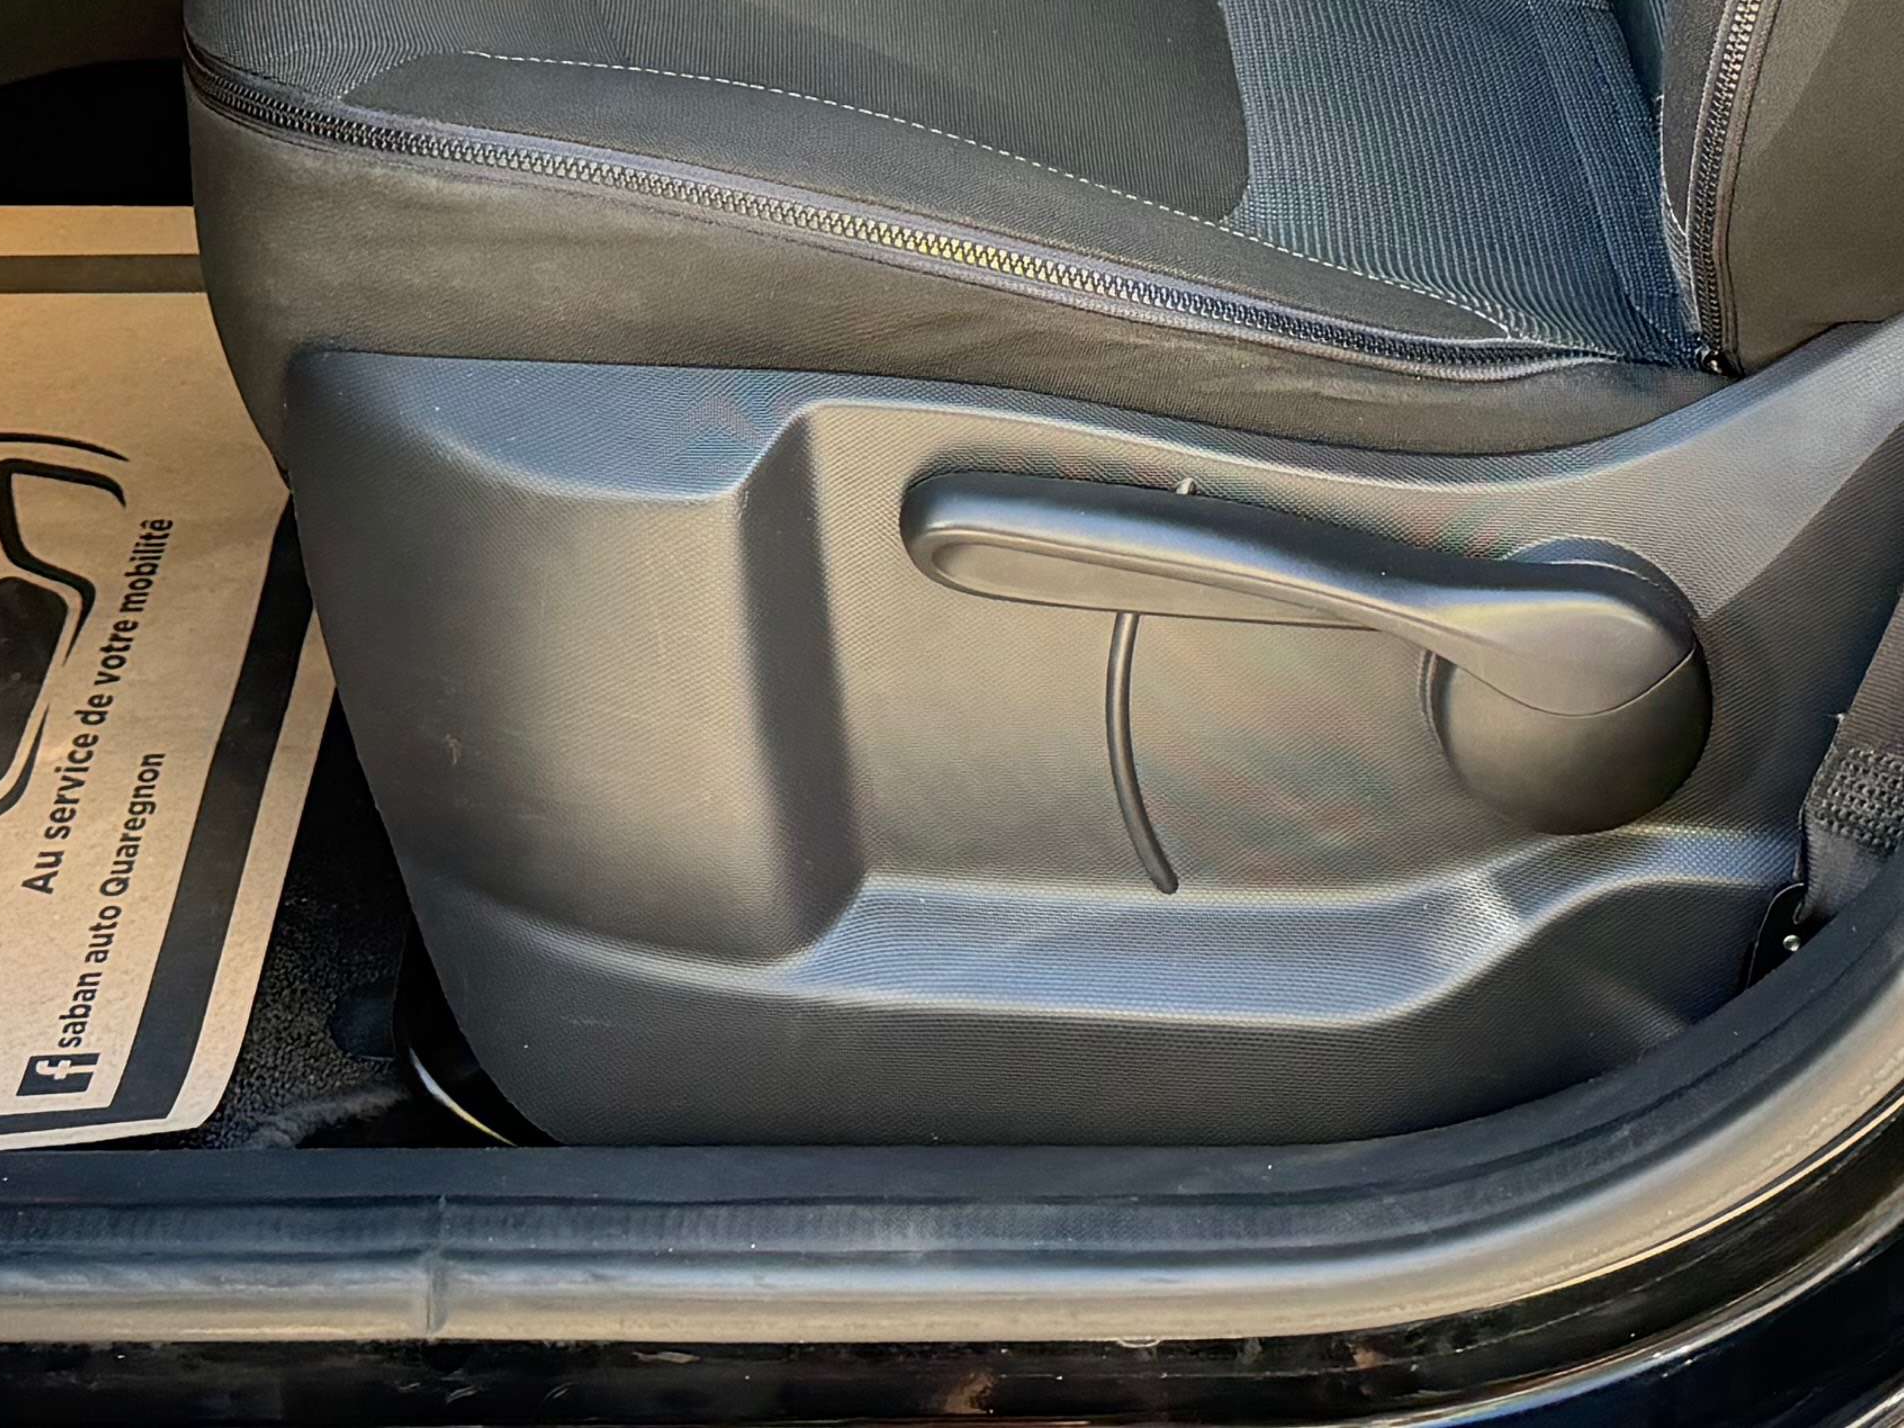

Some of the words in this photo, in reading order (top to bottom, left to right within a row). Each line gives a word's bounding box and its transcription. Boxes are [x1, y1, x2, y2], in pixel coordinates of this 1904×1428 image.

[94, 619, 138, 685] votre
[75, 693, 114, 727] de
[45, 732, 100, 842] service
[98, 752, 166, 898] Quaregnon
[21, 849, 65, 895] Au
[84, 905, 123, 966] auto
[58, 971, 103, 1049] saban
